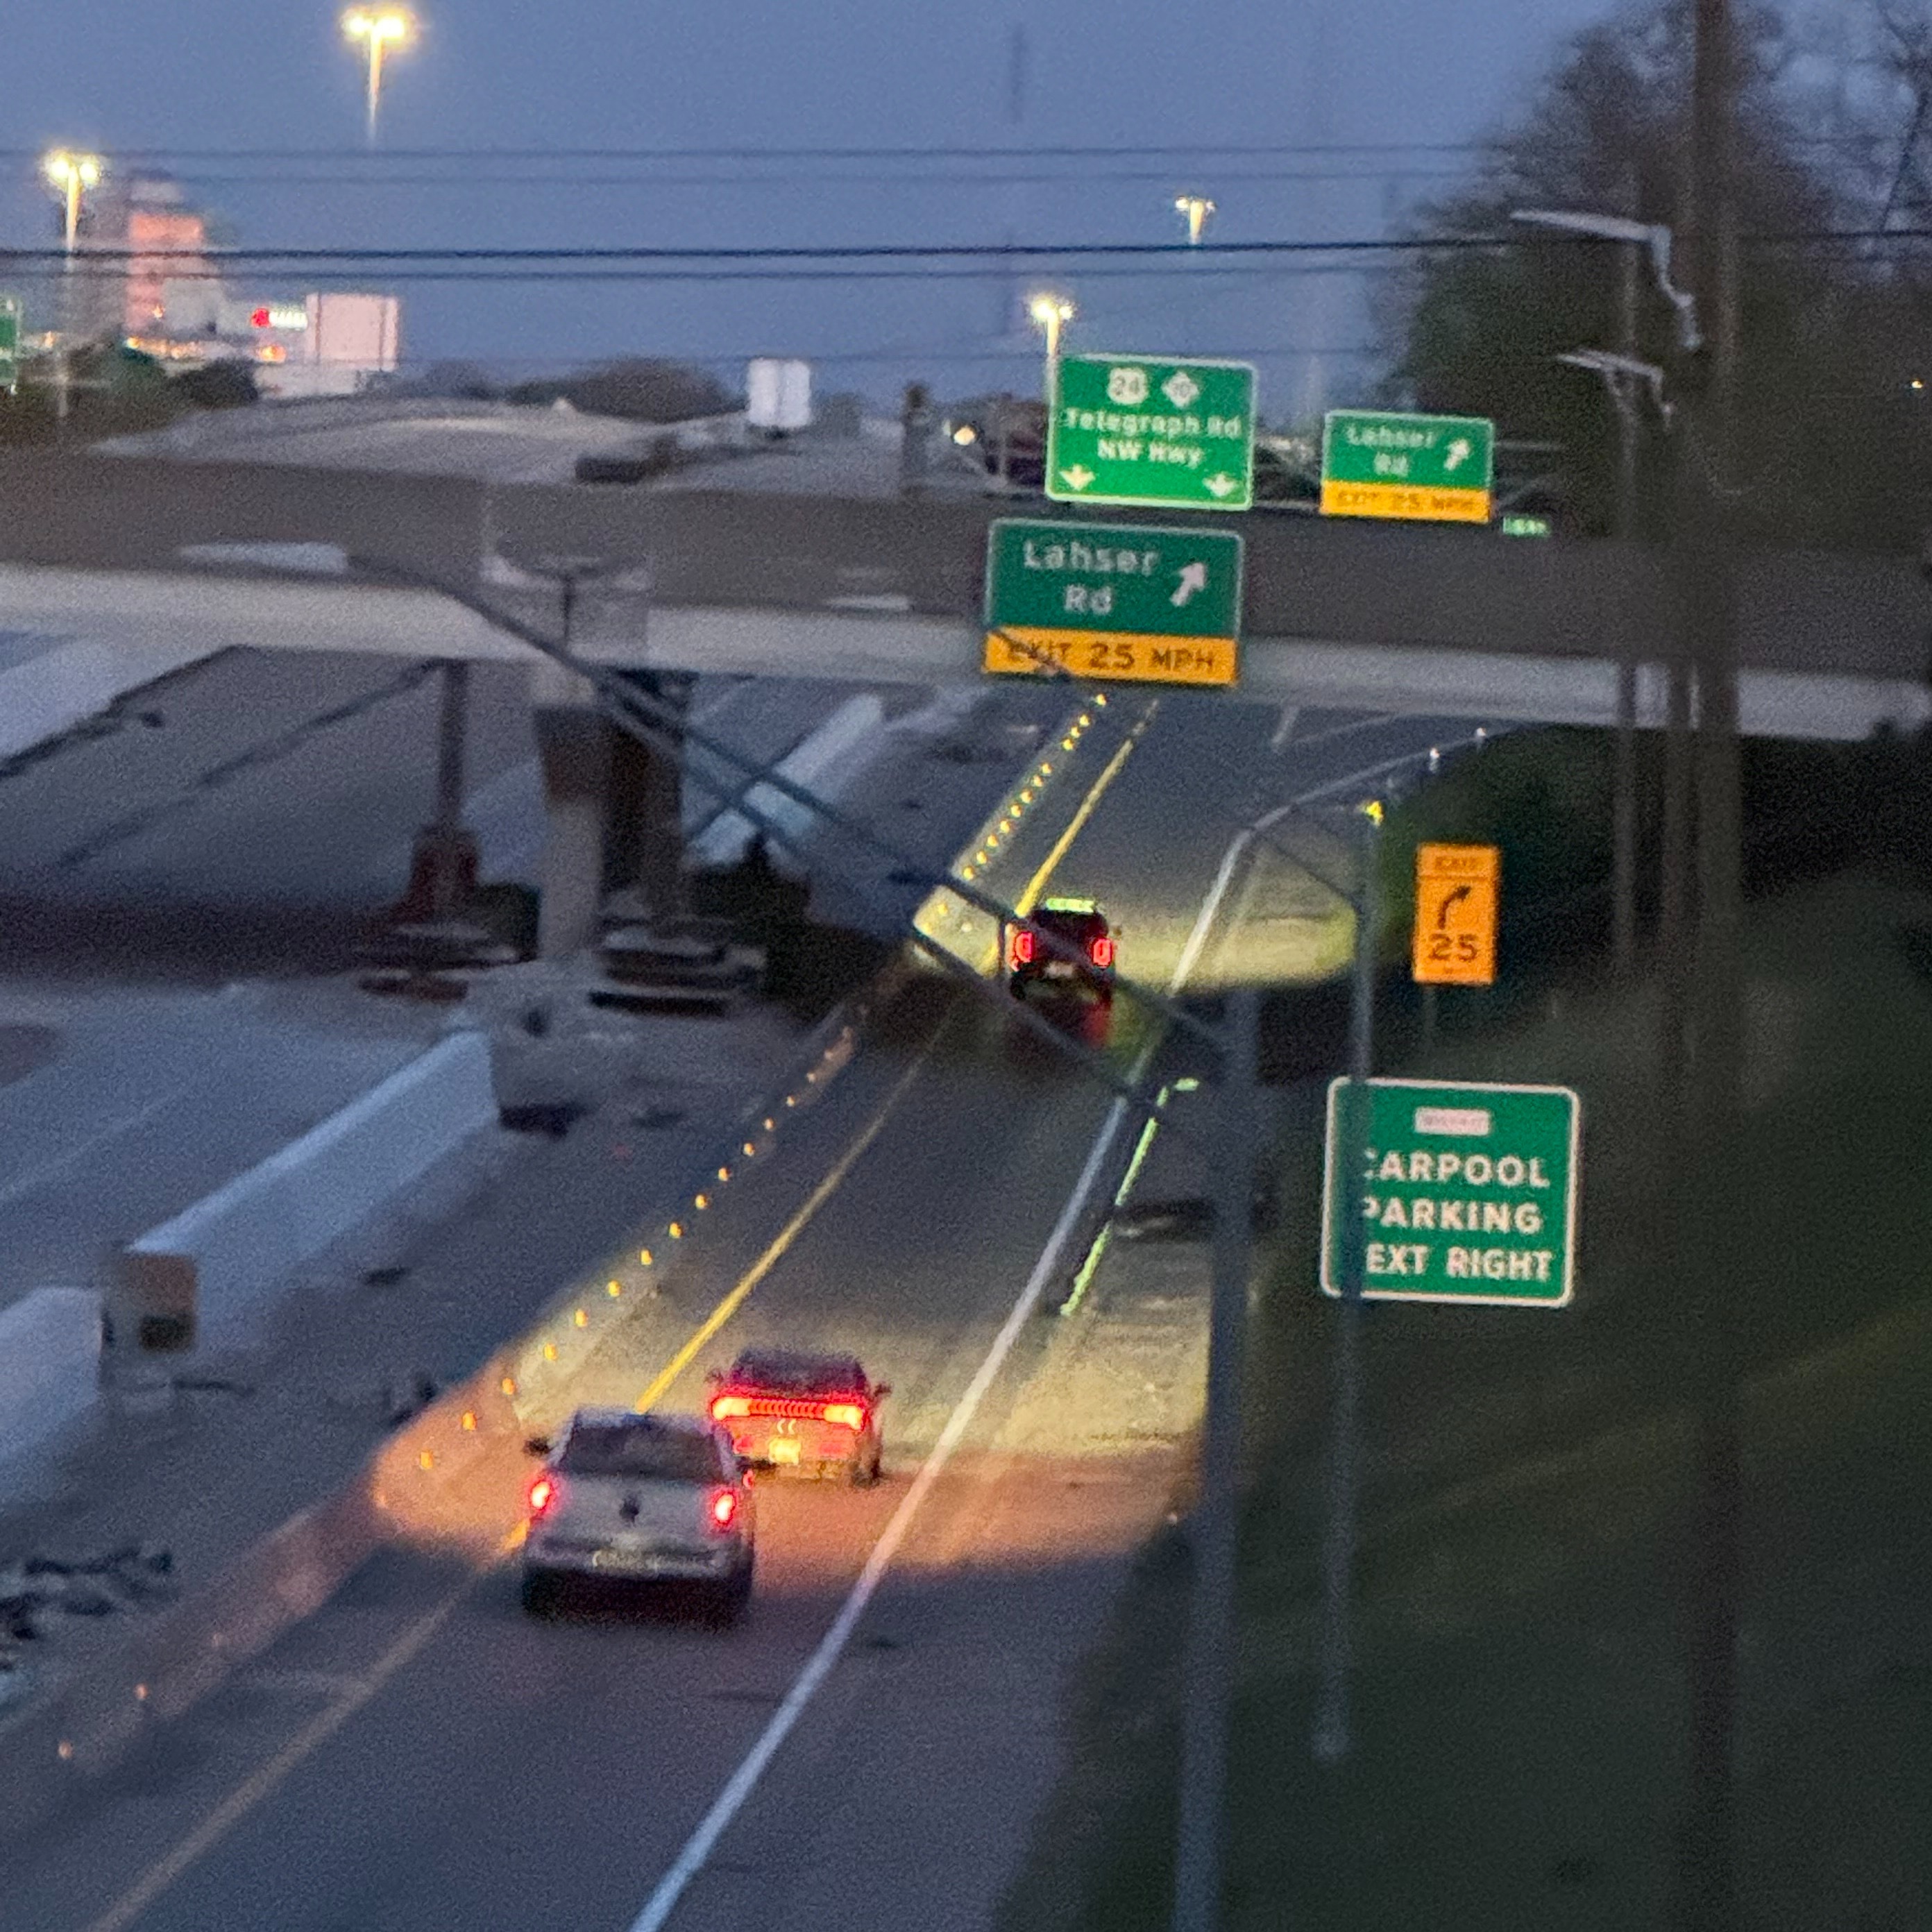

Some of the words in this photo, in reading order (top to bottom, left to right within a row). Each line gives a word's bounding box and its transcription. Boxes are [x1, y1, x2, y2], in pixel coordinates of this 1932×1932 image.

[1023, 541, 1160, 577] Lahser
[1065, 583, 1112, 616] Rd
[1089, 641, 1136, 670] 25
[1149, 645, 1215, 673] MPH
[1428, 933, 1479, 963] 25
[1364, 1243, 1429, 1276] EXT
[1446, 1246, 1554, 1283] RIGHT
